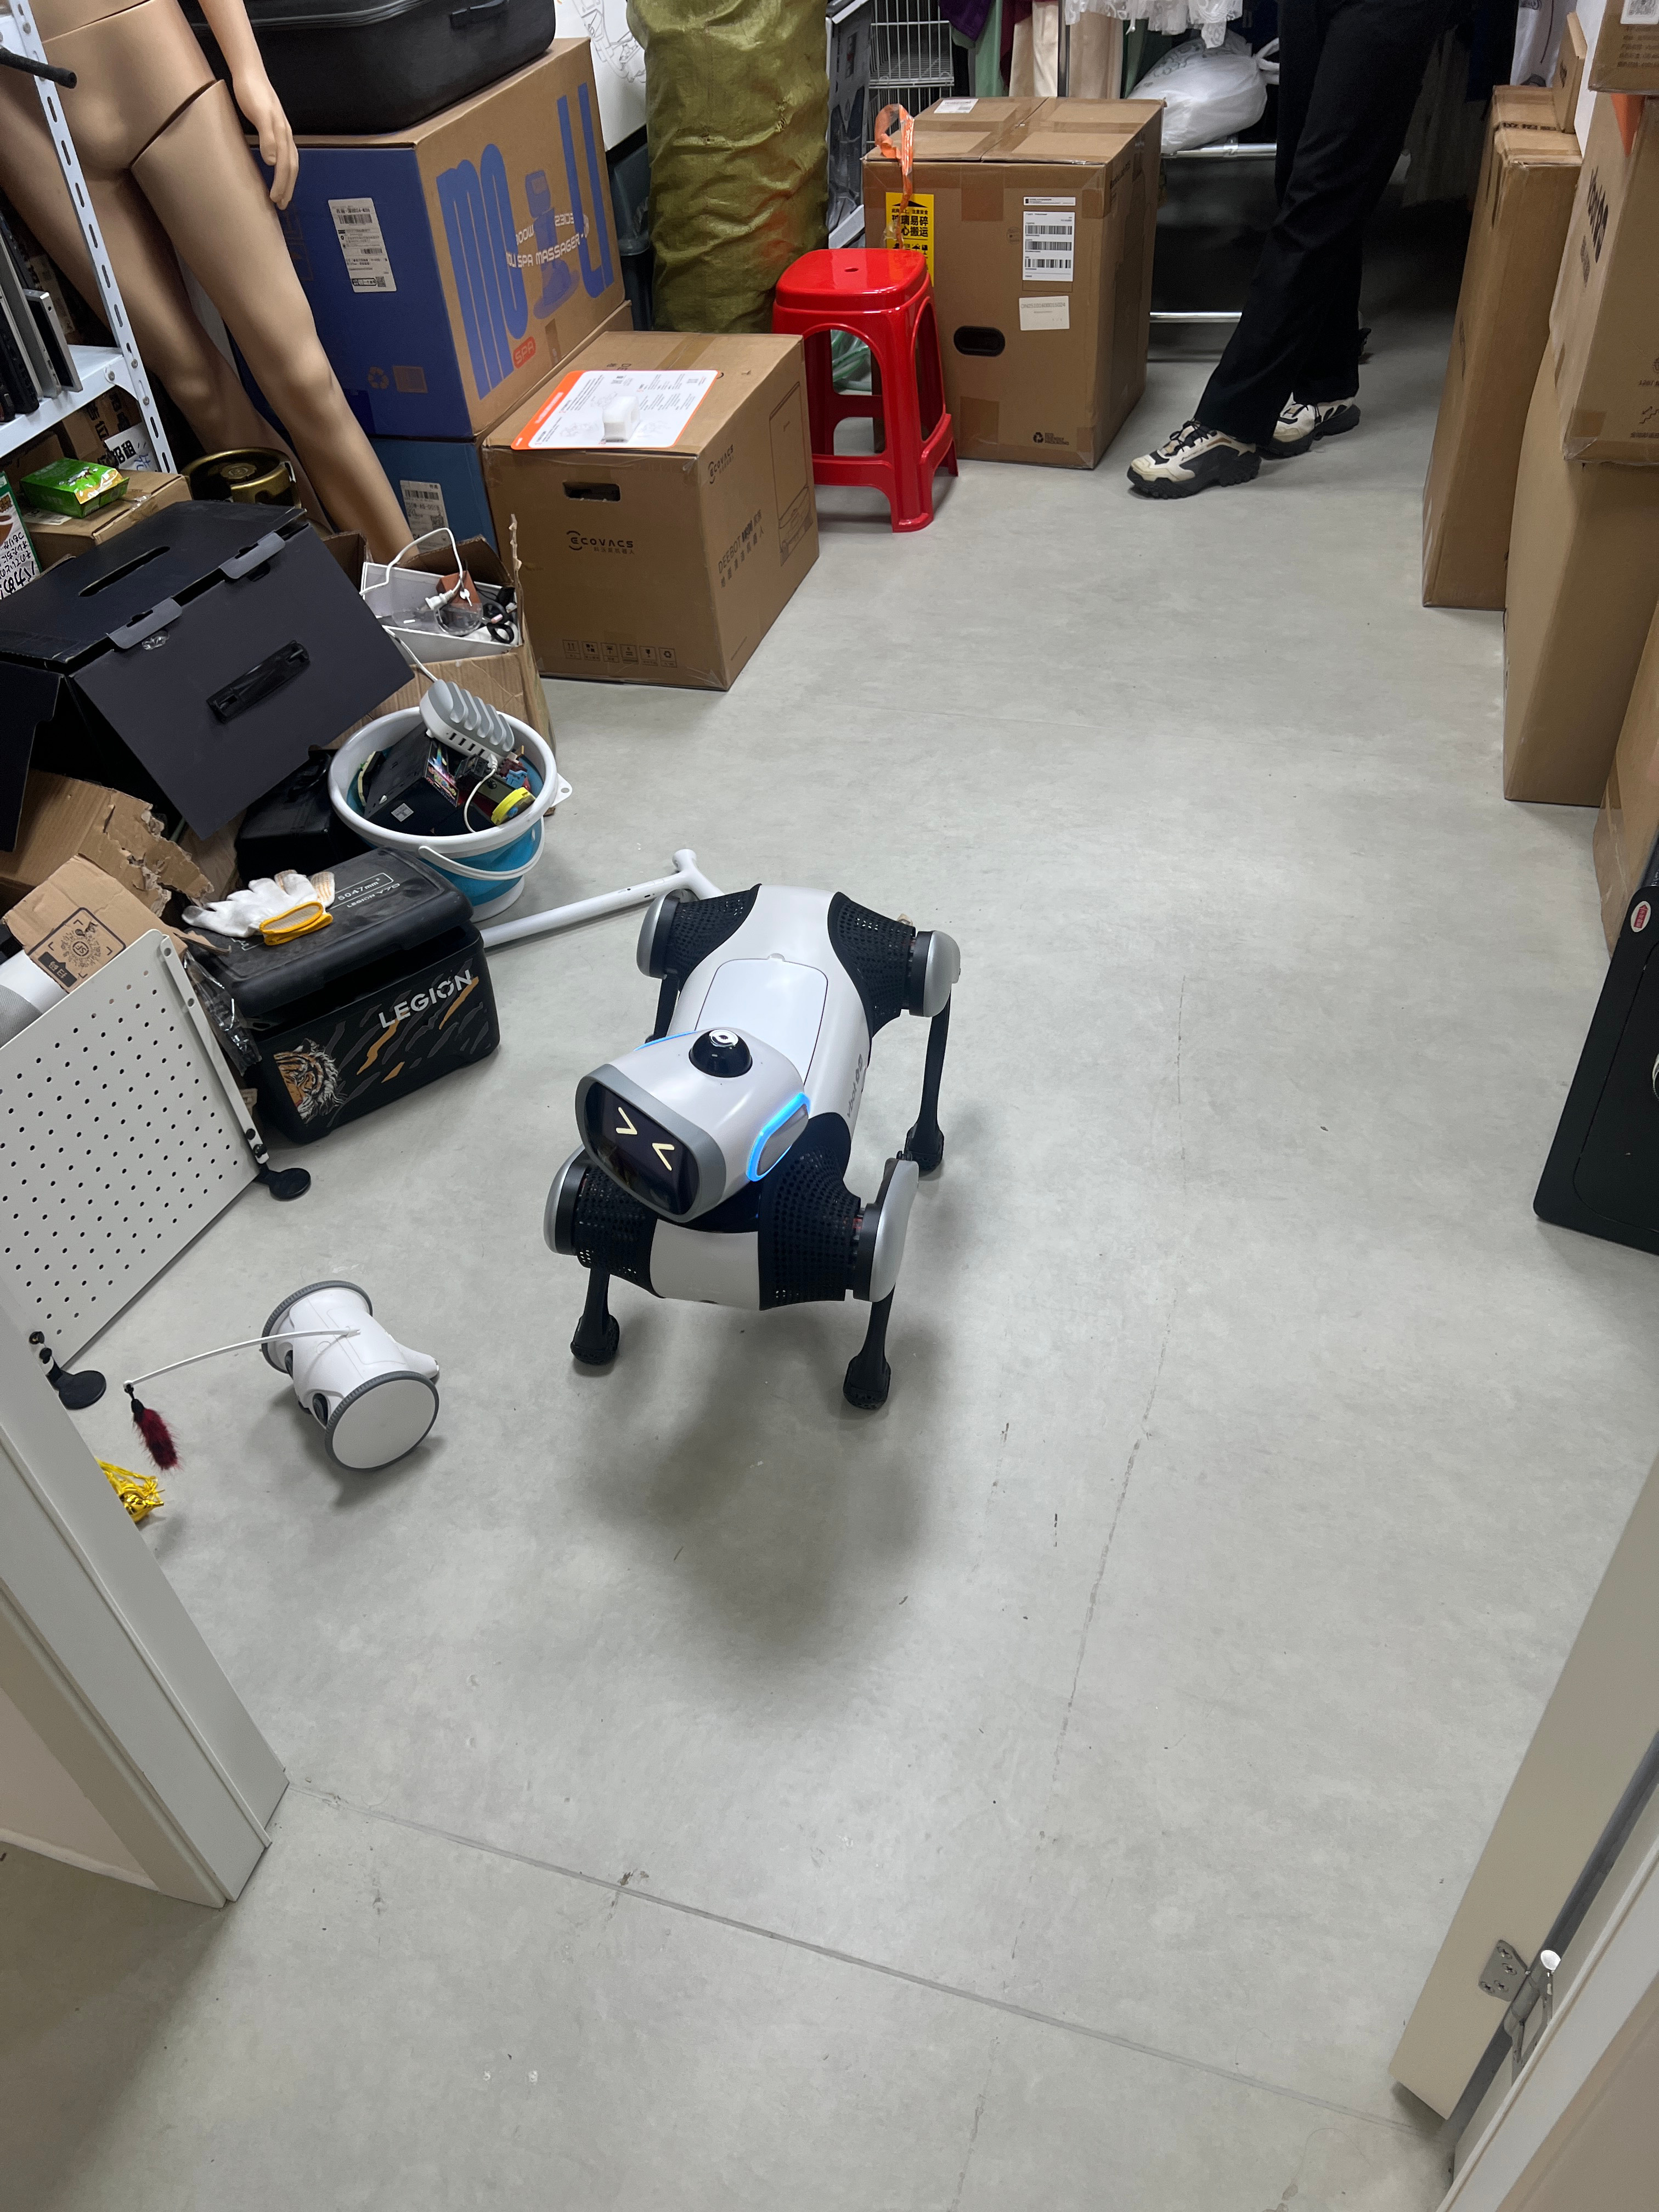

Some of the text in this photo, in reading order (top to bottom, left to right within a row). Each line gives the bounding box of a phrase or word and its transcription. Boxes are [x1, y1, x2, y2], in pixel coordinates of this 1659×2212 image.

[517, 254, 534, 268] SPA
[535, 233, 580, 265] MASSAGER
[515, 341, 533, 364] SPA
[567, 531, 634, 550] ECOVACS
[718, 535, 741, 574] DEEBOT
[347, 894, 375, 908] LEGION
[379, 969, 472, 1028] LEGION
